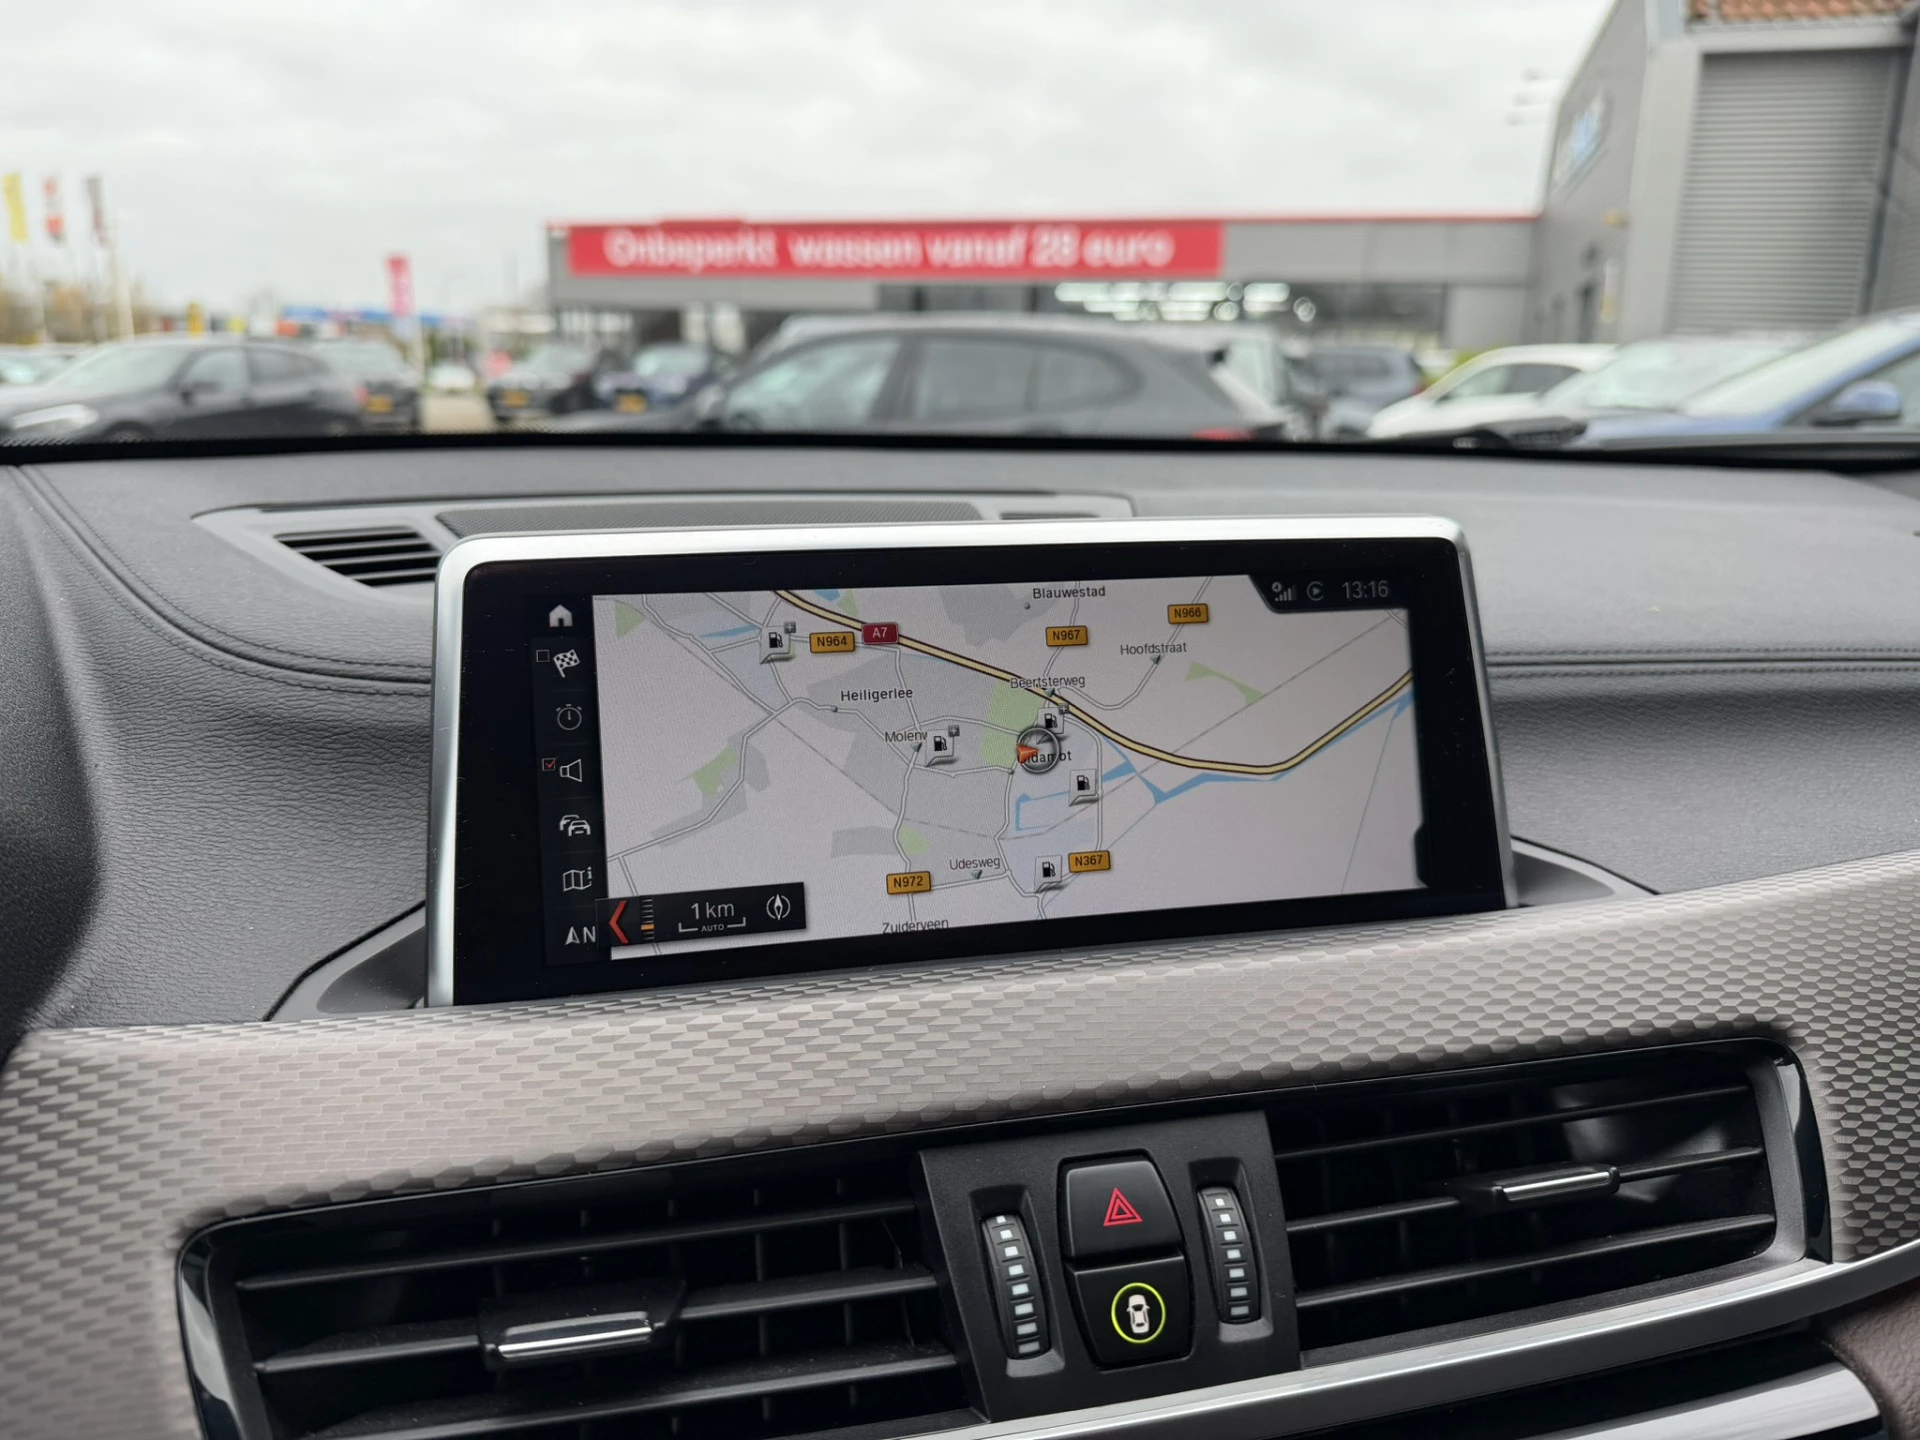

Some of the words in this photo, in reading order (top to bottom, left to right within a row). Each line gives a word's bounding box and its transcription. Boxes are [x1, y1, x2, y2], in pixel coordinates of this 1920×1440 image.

[787, 232, 922, 267] wassen
[924, 224, 1027, 267] vanaf
[1030, 224, 1081, 267] 28
[1083, 230, 1175, 267] euro
[1032, 586, 1106, 599] Blauwestad
[1342, 580, 1390, 599] 13:16
[1174, 608, 1202, 619] N966
[872, 627, 888, 639] A7
[1052, 630, 1081, 641] N967
[816, 635, 847, 648] N964
[1120, 642, 1188, 655] Hoofdstraat
[1010, 676, 1086, 689] Beertsterweg
[840, 688, 913, 702] Heiligerlee
[949, 856, 1001, 870] Udesweg
[1075, 854, 1103, 867] N367
[893, 876, 924, 888] N972
[706, 901, 735, 918] km
[701, 923, 725, 933] AUTO
[881, 919, 949, 934] Zuiderveen
